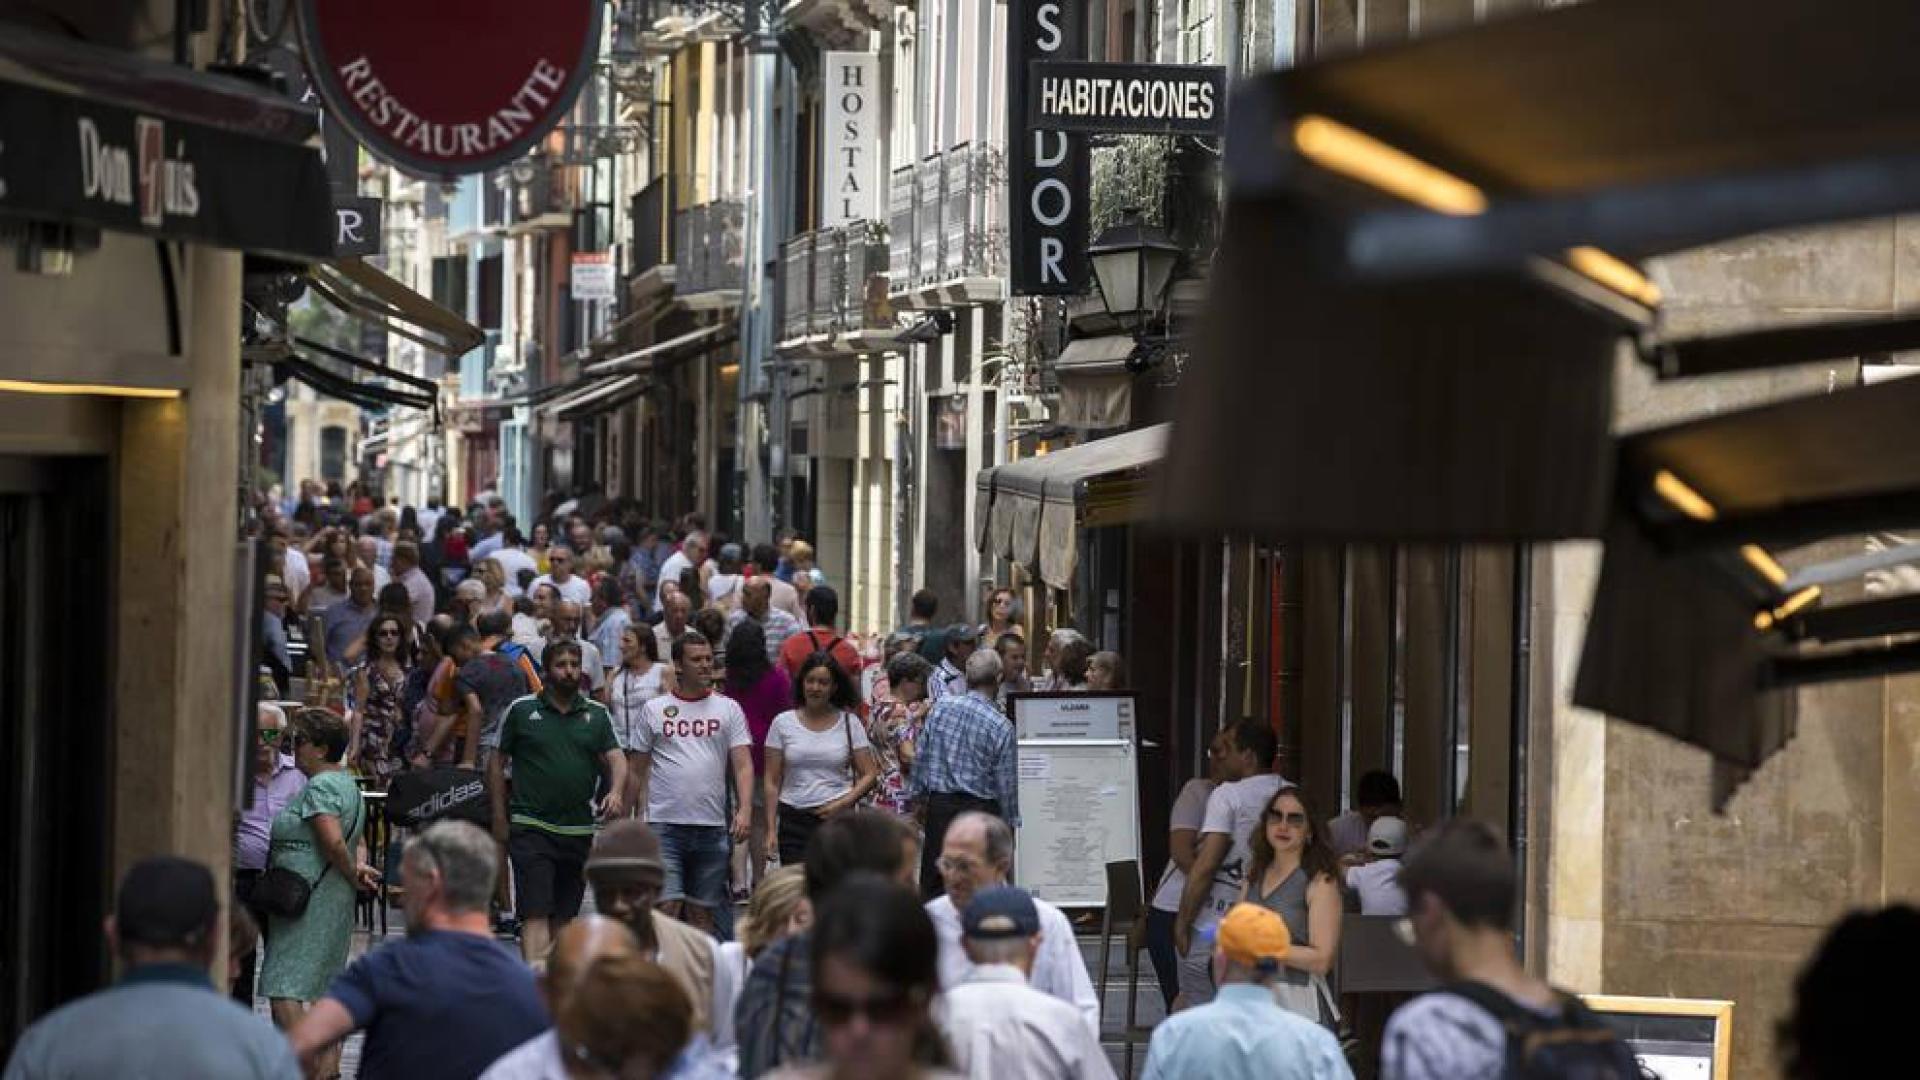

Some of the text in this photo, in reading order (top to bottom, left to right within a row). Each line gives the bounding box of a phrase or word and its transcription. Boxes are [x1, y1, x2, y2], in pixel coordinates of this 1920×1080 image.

[338, 56, 567, 157] RESTAURANTE
[1041, 77, 1215, 120] HABITACIONES
[77, 116, 133, 205] Don
[840, 64, 864, 219] HOSTAL
[662, 719, 721, 737] CCCP
[407, 780, 484, 817] adidas
